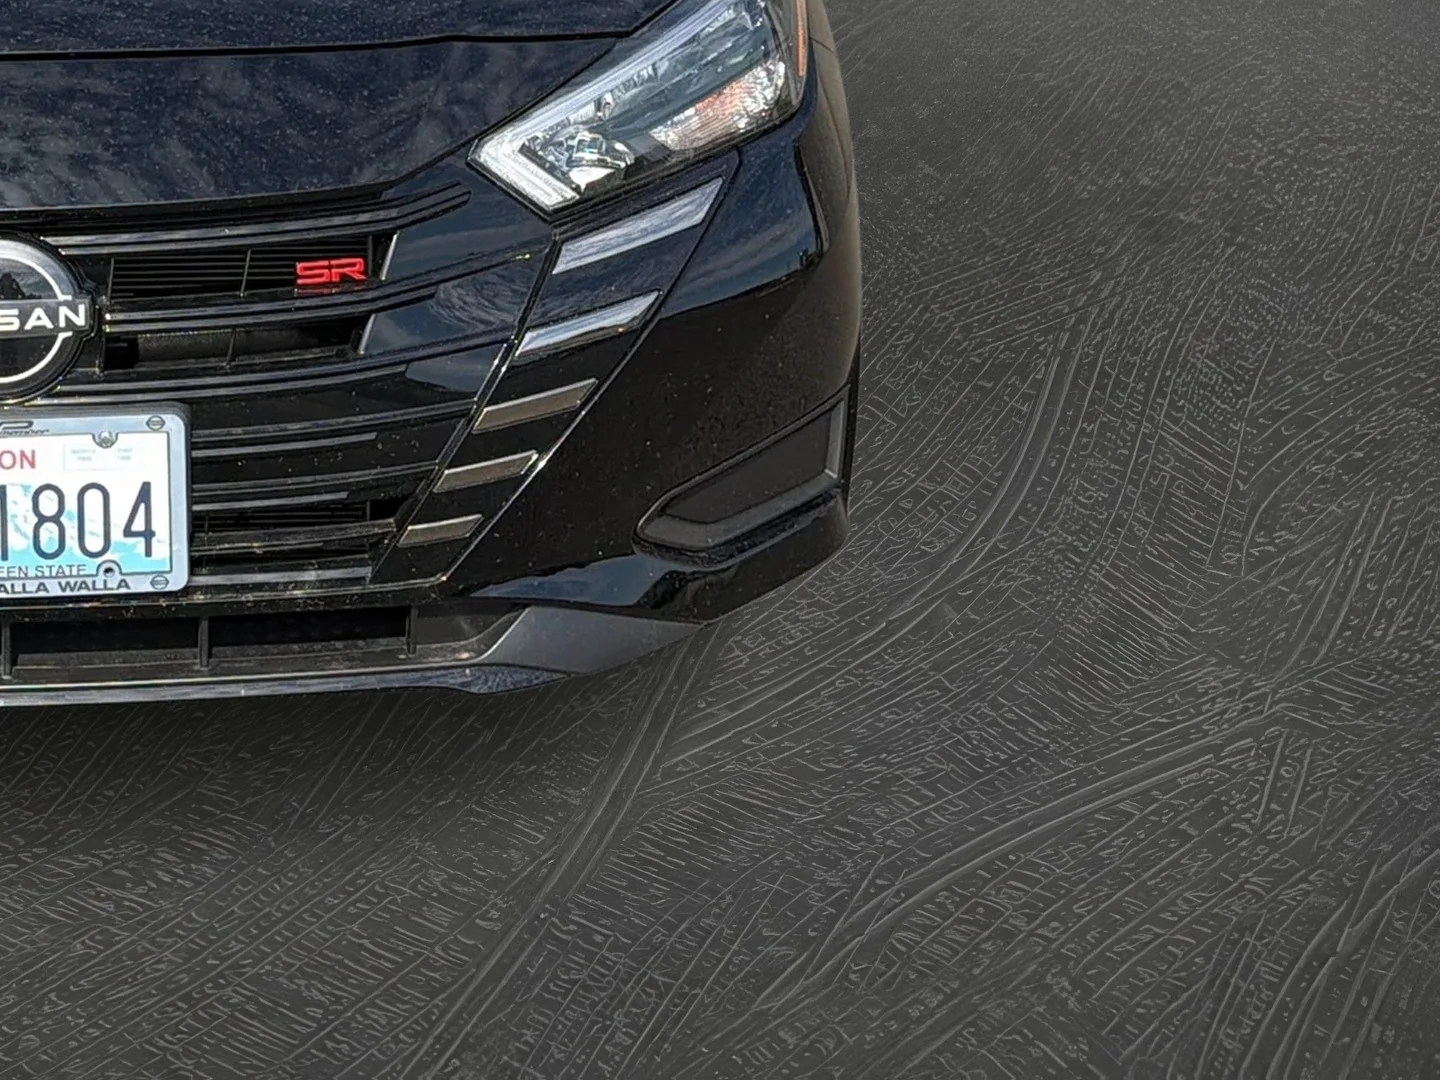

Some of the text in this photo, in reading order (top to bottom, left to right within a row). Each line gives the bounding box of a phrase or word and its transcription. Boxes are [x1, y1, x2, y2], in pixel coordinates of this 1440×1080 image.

[296, 257, 367, 285] SR
[34, 564, 87, 577] STATE
[59, 578, 131, 593] WALLA
